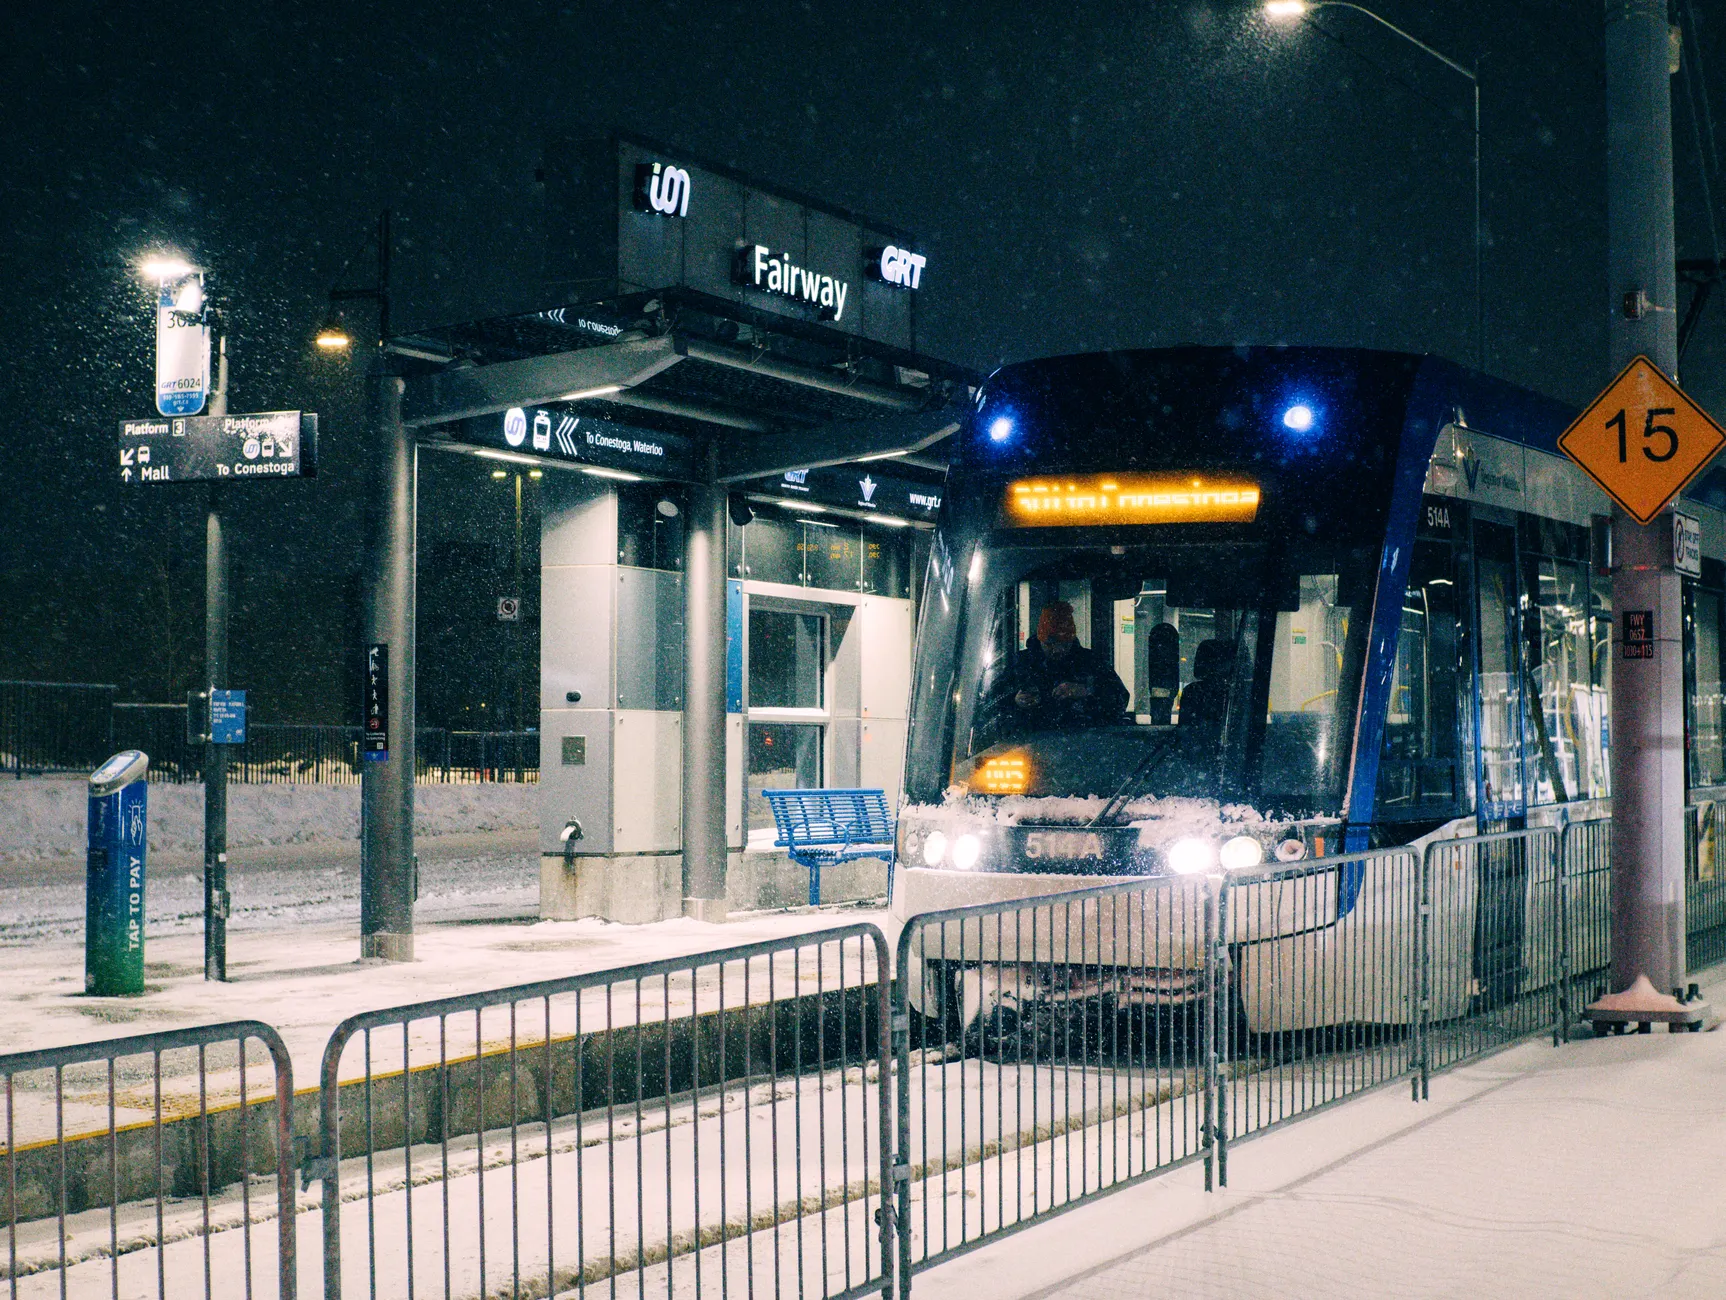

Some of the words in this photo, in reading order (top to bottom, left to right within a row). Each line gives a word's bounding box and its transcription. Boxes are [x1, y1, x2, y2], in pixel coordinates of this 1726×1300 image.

[881, 245, 926, 289] GRT
[755, 245, 847, 322] Fairway
[177, 378, 201, 389] 6024
[125, 423, 169, 436] Platform
[175, 422, 183, 434] 3
[225, 417, 269, 431] Platform
[1605, 408, 1679, 463] 15
[586, 432, 594, 443] To
[595, 434, 632, 451] Conestoga,
[633, 440, 663, 456] Waterloo
[141, 465, 169, 481] Mall
[216, 464, 229, 476] To
[235, 462, 294, 476] Conestoga
[1427, 506, 1451, 529] 514A
[1026, 833, 1102, 859] 514A
[129, 856, 140, 888] PAY
[129, 893, 140, 916] TO
[129, 919, 140, 952] TAP
